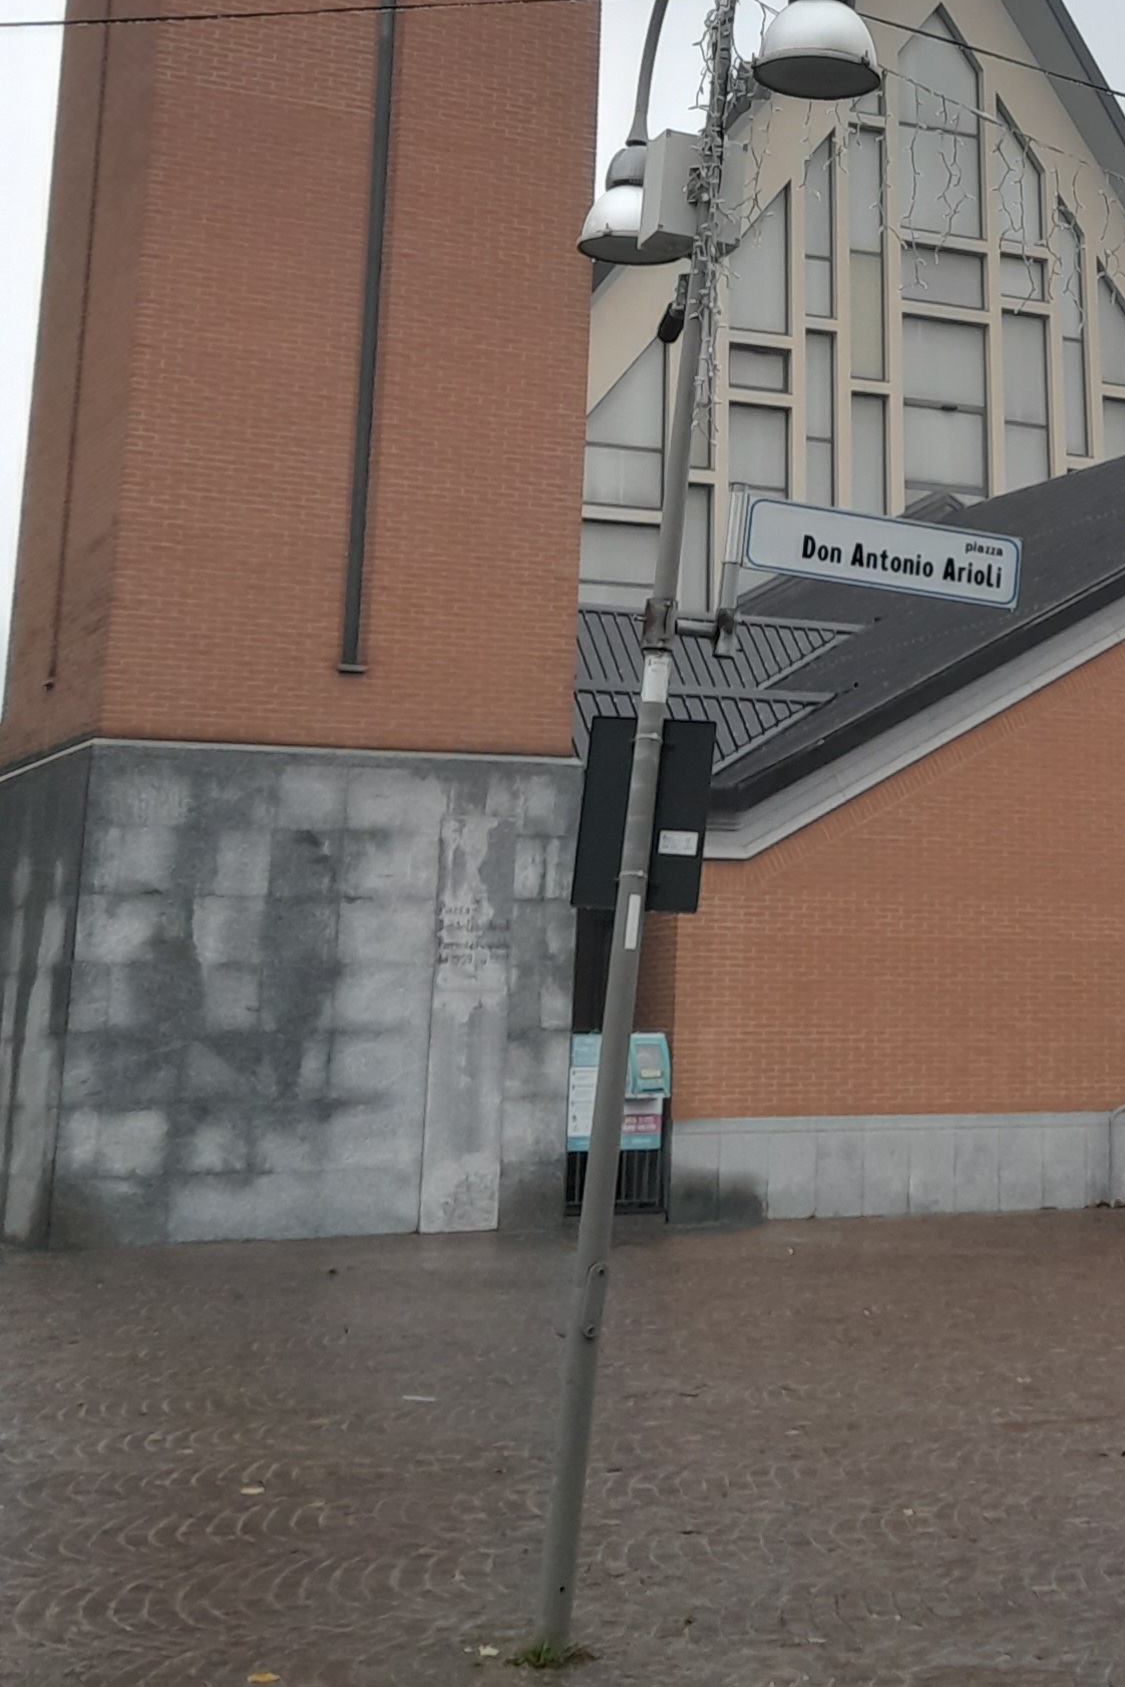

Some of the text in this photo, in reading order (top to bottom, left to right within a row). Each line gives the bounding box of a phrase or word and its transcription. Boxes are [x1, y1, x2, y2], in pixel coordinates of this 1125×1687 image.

[802, 535, 1003, 589] Don Antonio Arioli
[965, 541, 1003, 556] piazza
